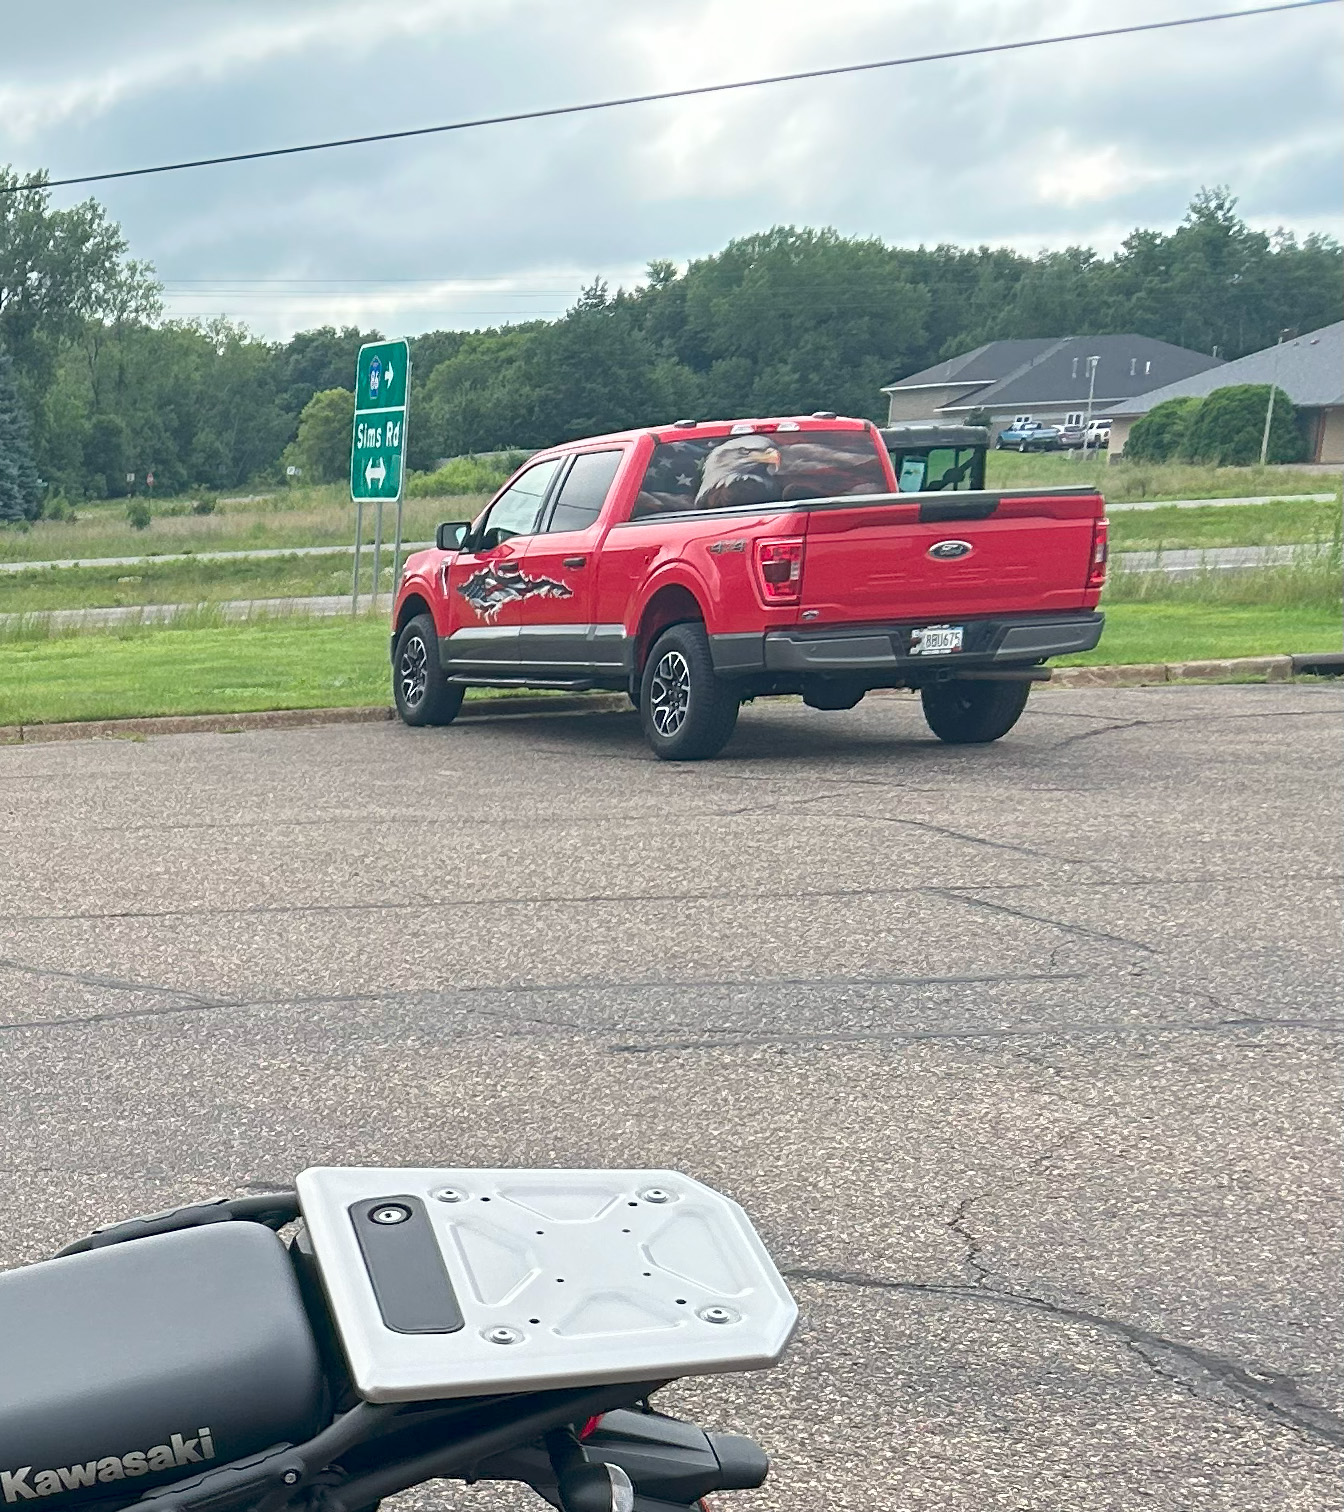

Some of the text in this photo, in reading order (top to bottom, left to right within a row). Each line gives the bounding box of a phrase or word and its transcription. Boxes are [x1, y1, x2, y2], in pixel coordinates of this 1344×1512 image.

[357, 420, 401, 449] Sims Rd
[0, 1427, 216, 1503] Kawasaki
